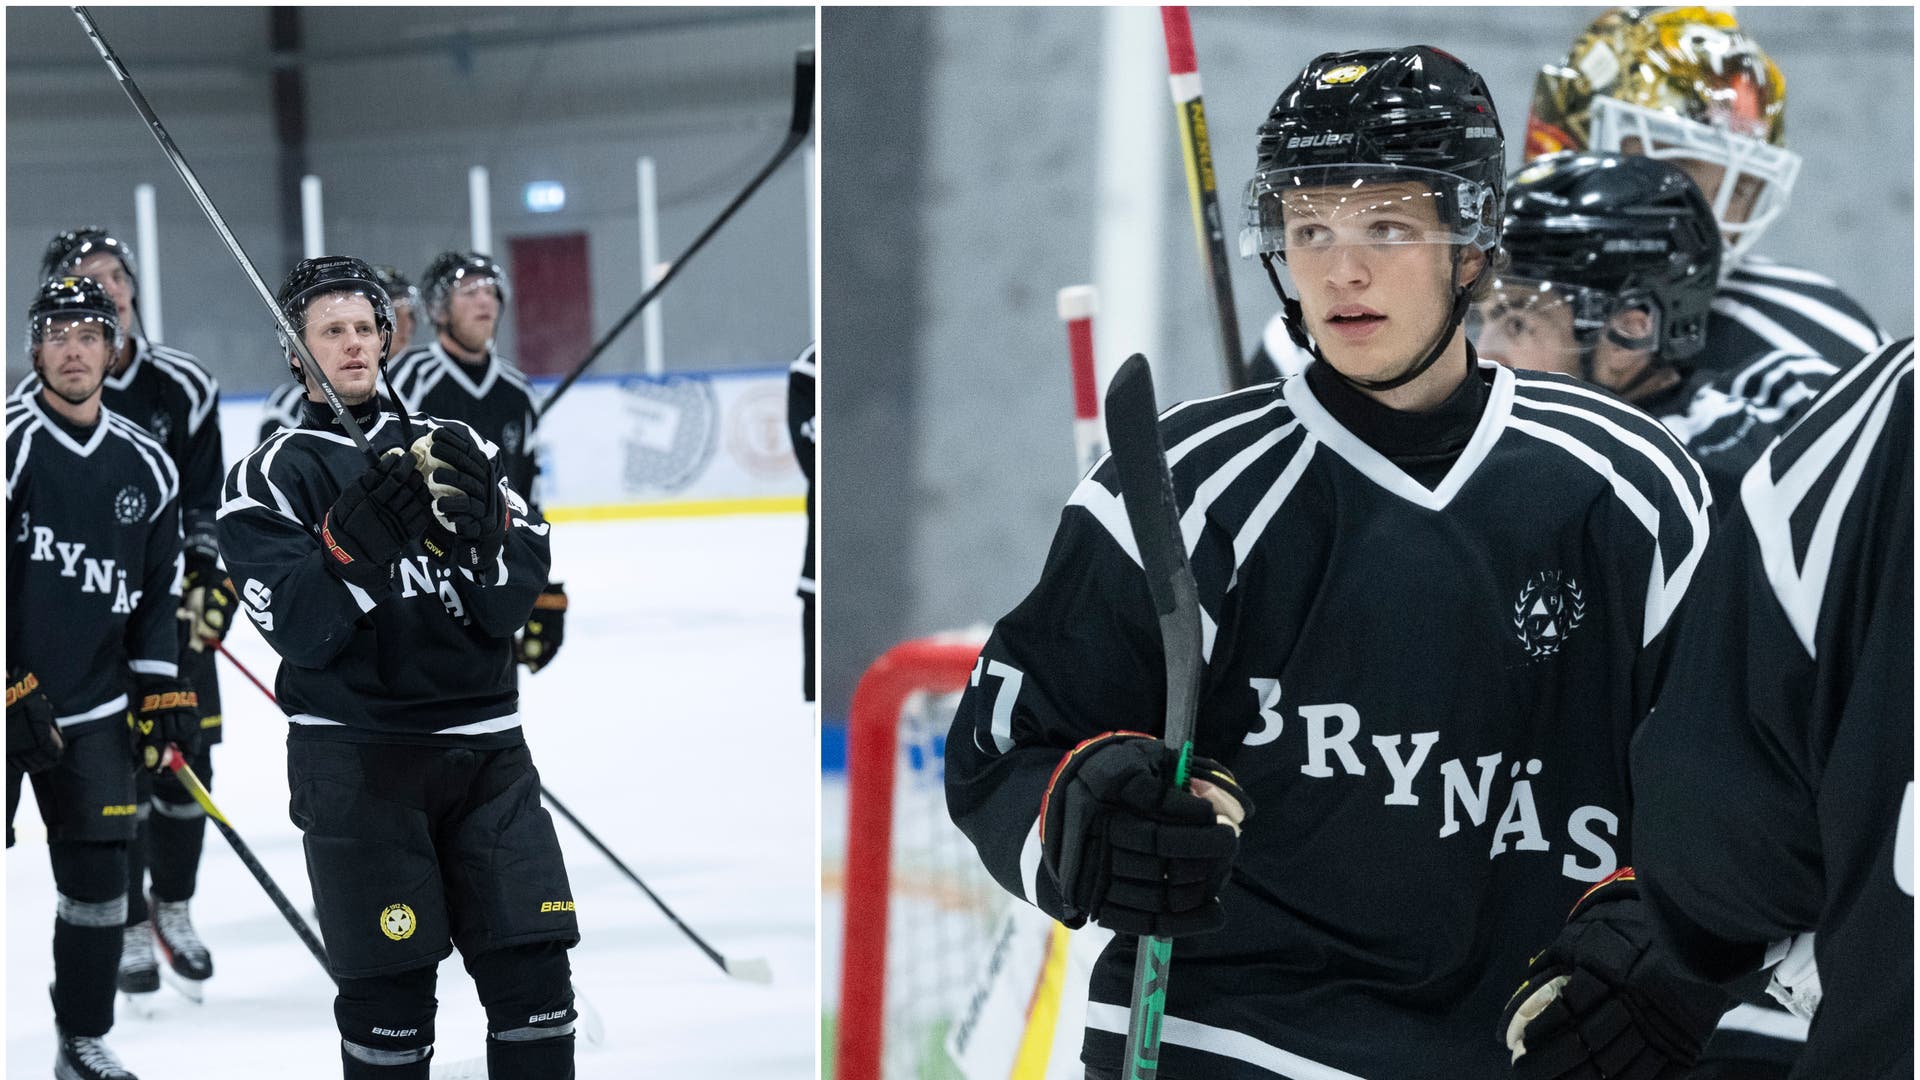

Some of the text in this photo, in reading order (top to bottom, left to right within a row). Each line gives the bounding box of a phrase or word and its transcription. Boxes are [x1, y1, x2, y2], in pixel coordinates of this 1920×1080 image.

[1286, 133, 1354, 149] BAUER
[528, 1008, 568, 1024] BAUER
[371, 1026, 418, 1038] BAUER
